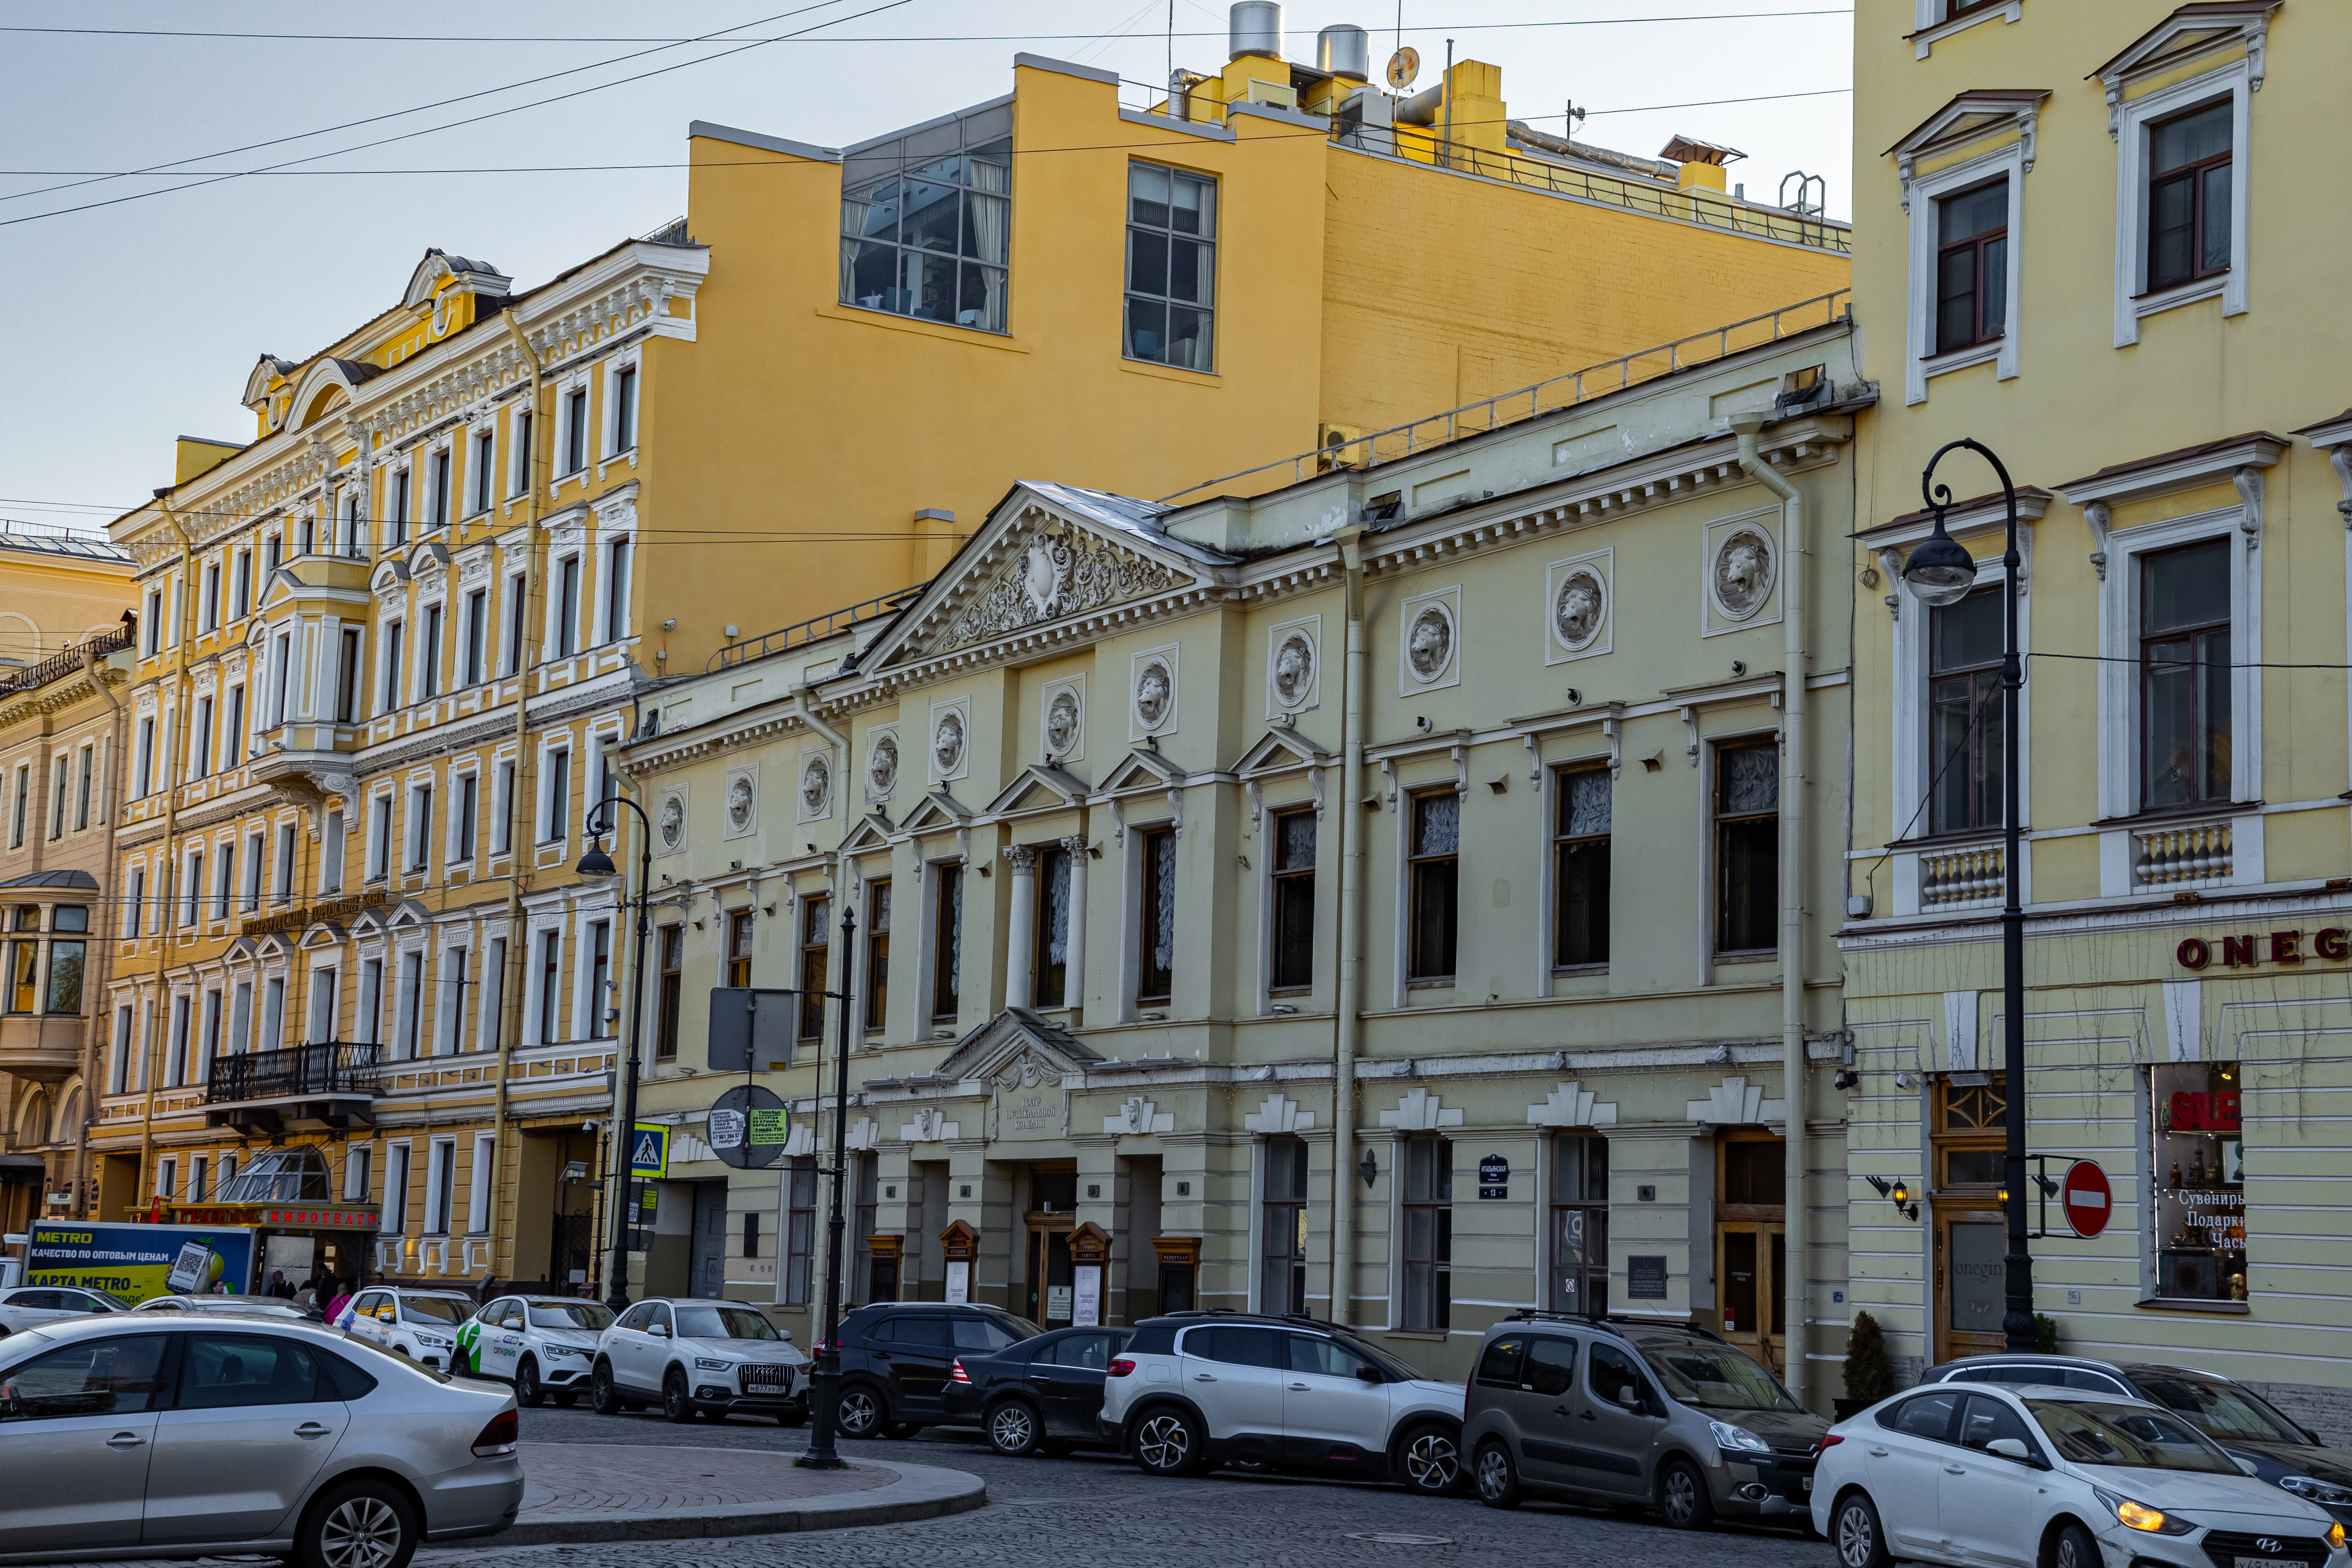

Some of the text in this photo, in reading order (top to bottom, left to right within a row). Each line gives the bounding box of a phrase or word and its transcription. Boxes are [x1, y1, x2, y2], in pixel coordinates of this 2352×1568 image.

[243, 890, 387, 934] ПЕТЕРБУРГСКИЙ ГОРОДСКОЙ БАНК
[2177, 928, 2349, 969] ONEG
[1022, 1097, 1041, 1107] ТЕАТР
[1006, 1105, 1056, 1119] МУЗЫКАЛЬНОЙ
[2171, 1091, 2238, 1130] SALE
[1015, 1119, 1045, 1130] КОМЕДИИ
[271, 1211, 375, 1224] КИНОТЕАТР
[2187, 1211, 2246, 1231] Подарки
[36, 1232, 93, 1244] METRO
[31, 1249, 169, 1262] КАЧЕСТВО ПО ОПТОВЫМ ЦЕНАМ
[1955, 1260, 2002, 1283] onegin
[28, 1274, 77, 1286] КАРТА
[81, 1276, 131, 1291] METRO
